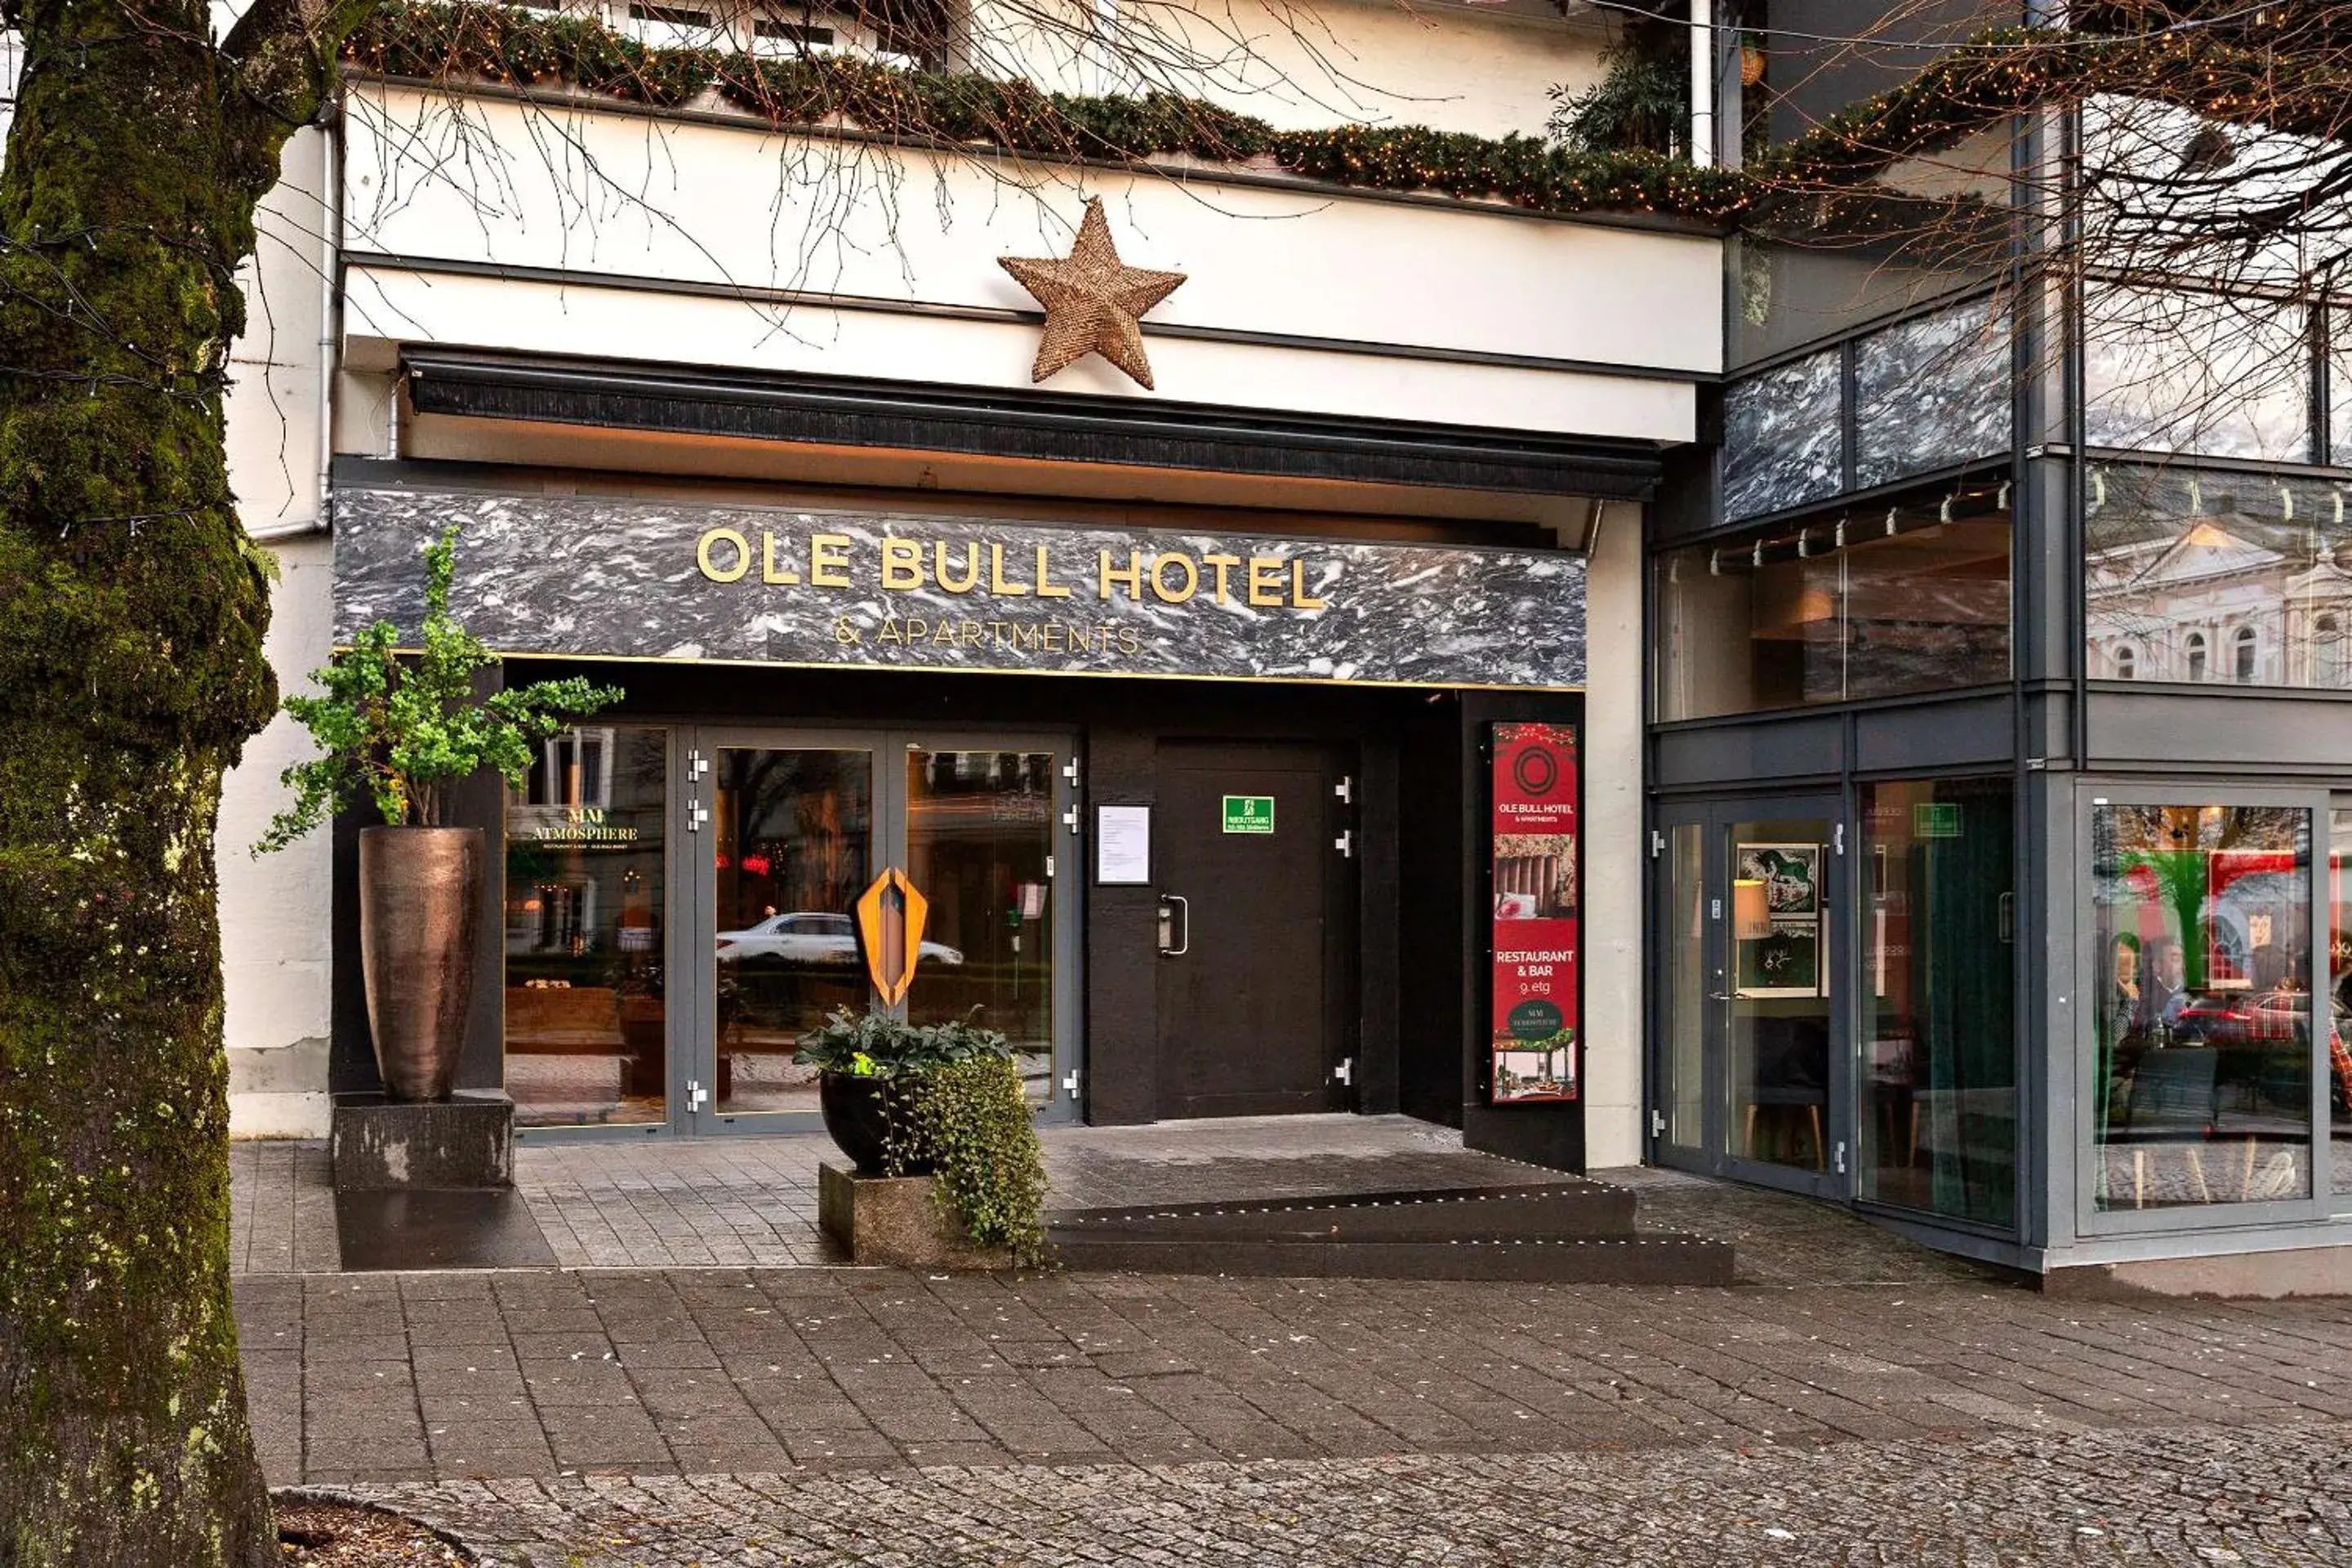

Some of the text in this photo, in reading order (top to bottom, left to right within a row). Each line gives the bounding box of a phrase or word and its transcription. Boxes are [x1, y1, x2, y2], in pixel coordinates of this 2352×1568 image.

[697, 528, 1325, 608] OLE BULL HOTEL
[832, 616, 1139, 654] & APARTMENTS
[1499, 804, 1574, 814] OLE BULL HOTEL
[532, 827, 638, 840] ATMOSPHERE
[1496, 951, 1575, 963] RESTAURANT
[1517, 964, 1553, 977] & BAR
[1531, 981, 1551, 995] etg
